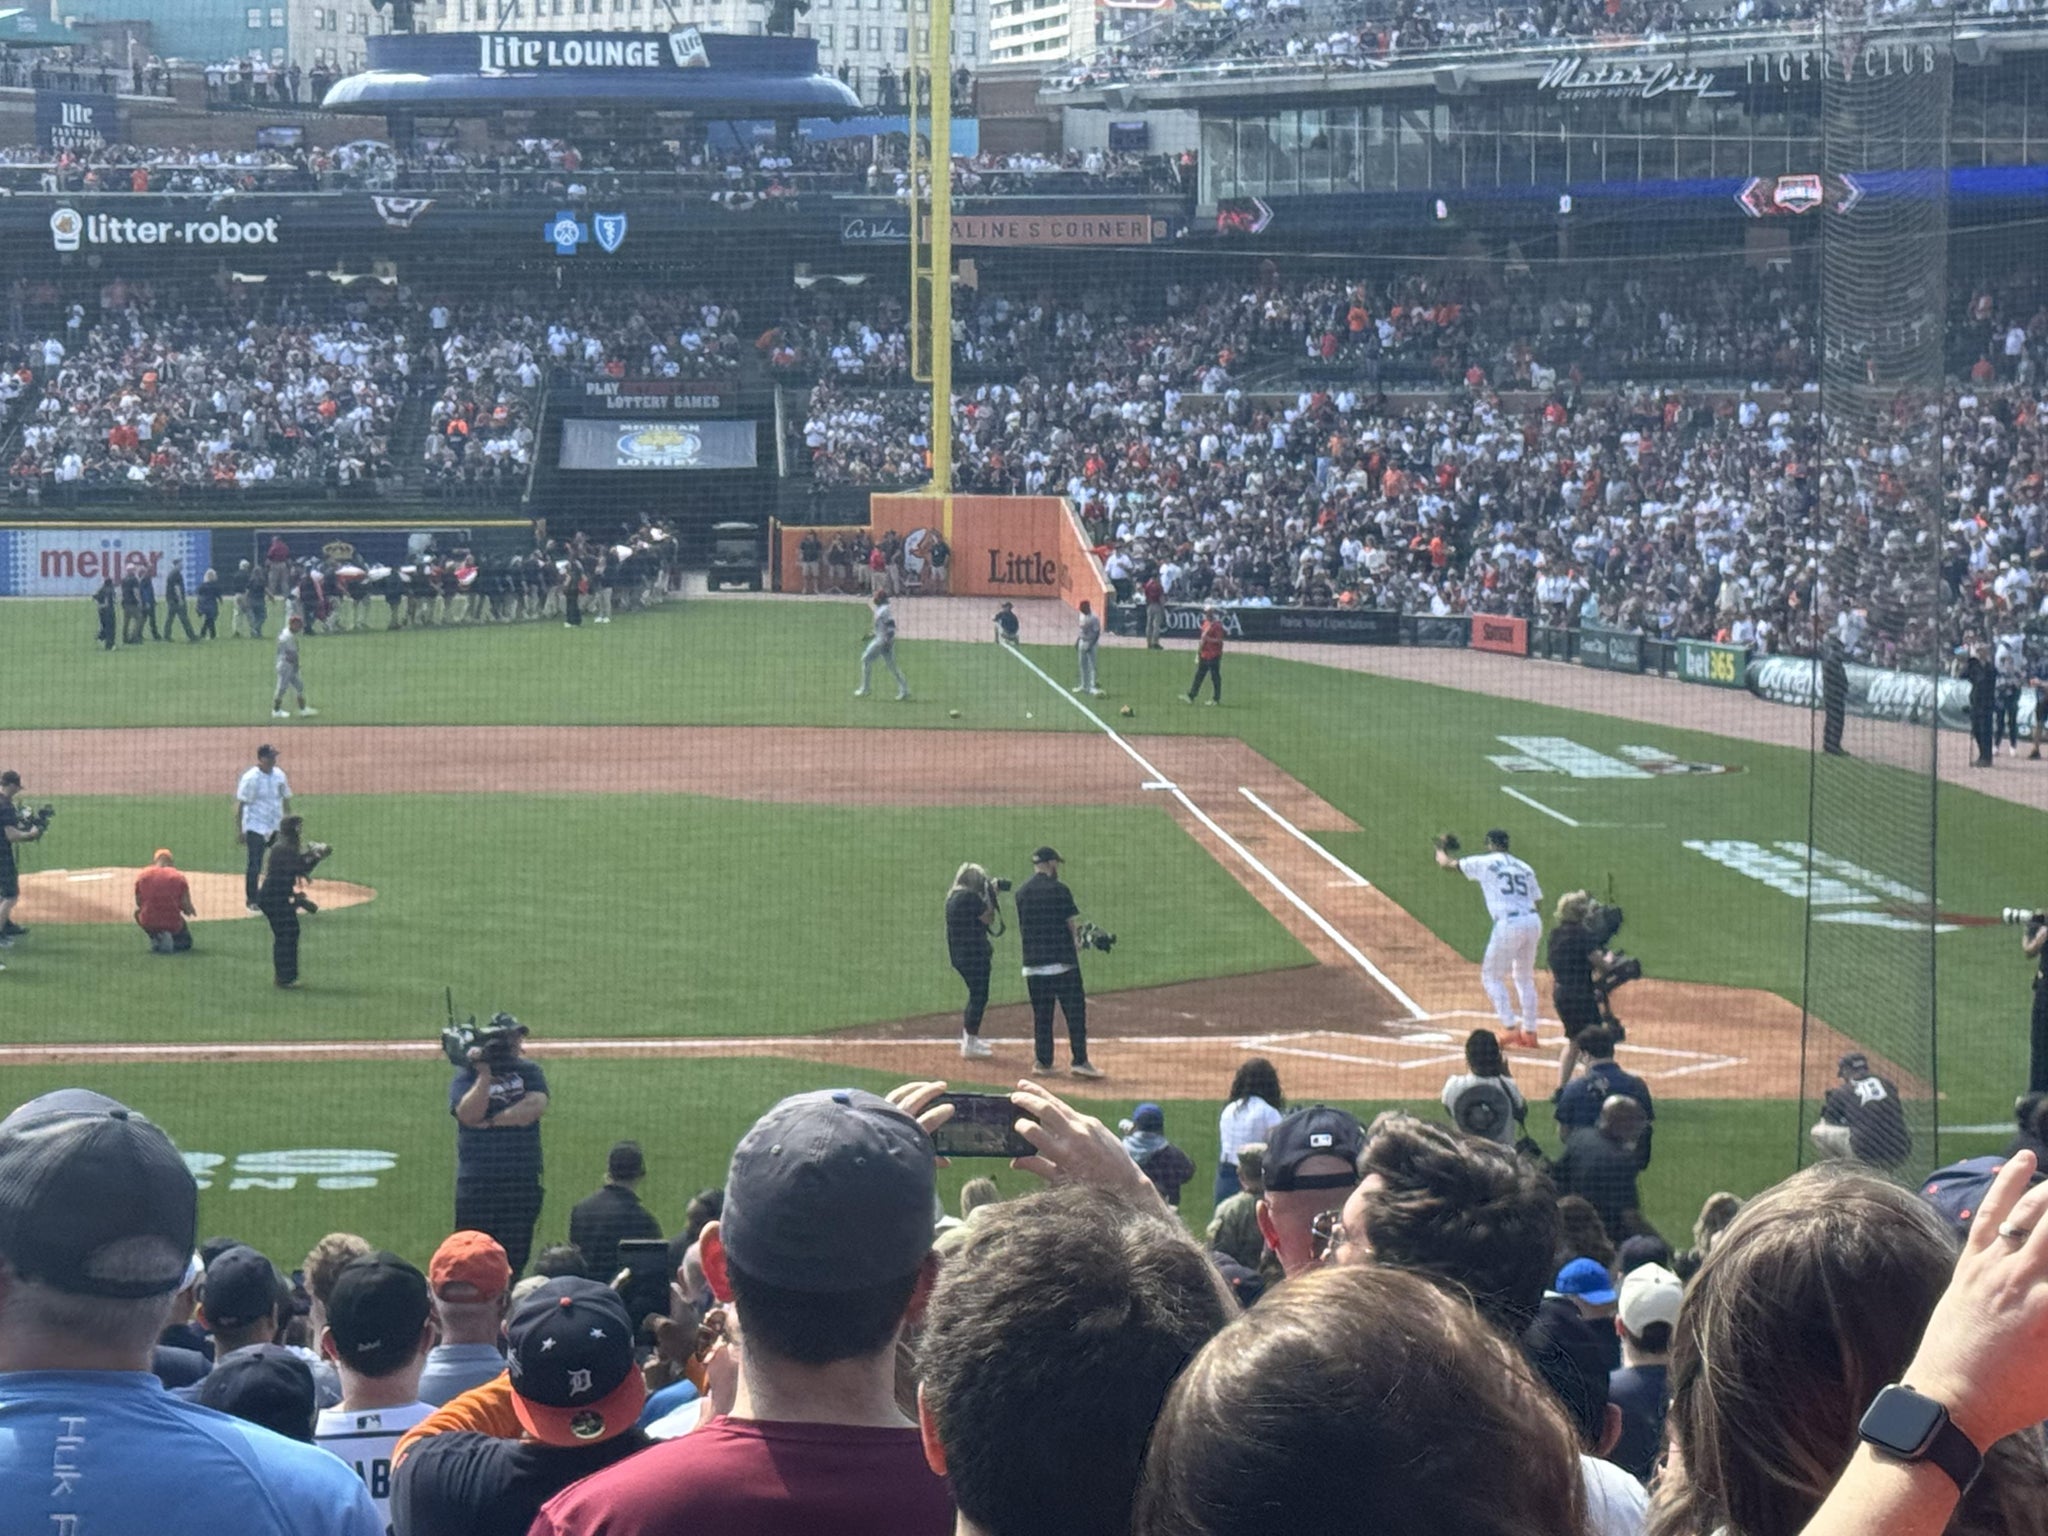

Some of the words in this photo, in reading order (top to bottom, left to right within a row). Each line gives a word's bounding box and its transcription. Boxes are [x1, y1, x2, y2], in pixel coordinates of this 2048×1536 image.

[478, 35, 542, 77] Lite
[547, 40, 660, 67] LOUNGE
[1744, 51, 1831, 84] TIGER
[1864, 43, 1935, 77] CLUB
[61, 102, 93, 127] Lite
[1051, 221, 1143, 239] CORNER
[586, 383, 620, 396] PLAY
[607, 396, 669, 409] LOTTERY
[674, 396, 721, 409] GAMES
[619, 423, 700, 433] MICHIGAN
[616, 457, 699, 467] LOTTERY
[40, 538, 164, 587] meijer
[987, 548, 1057, 585] Little
[1686, 644, 1735, 683] bet365
[1497, 871, 1529, 897] 35
